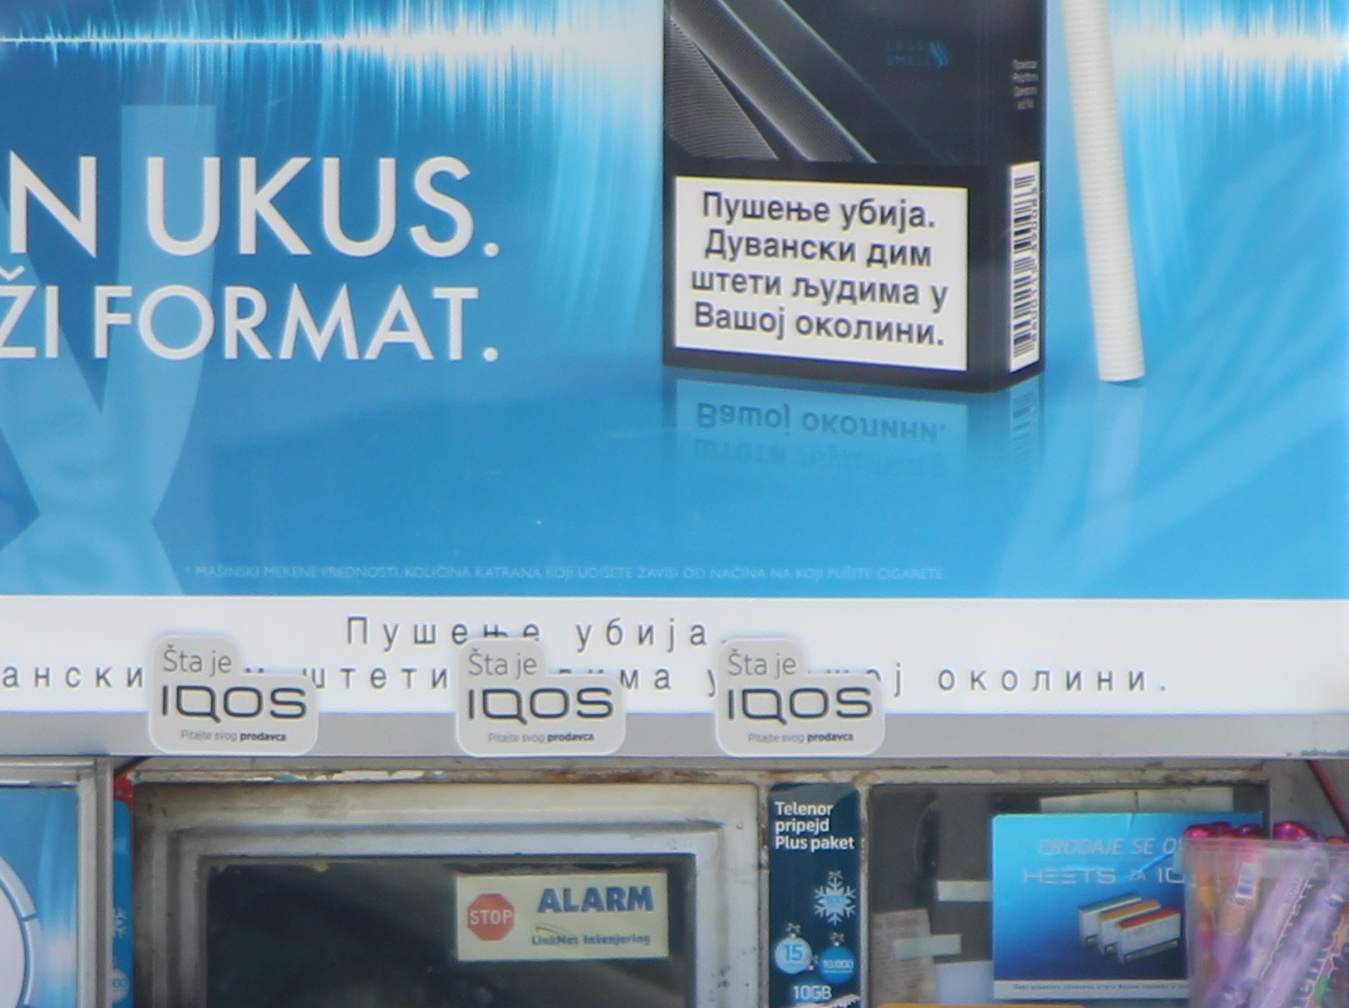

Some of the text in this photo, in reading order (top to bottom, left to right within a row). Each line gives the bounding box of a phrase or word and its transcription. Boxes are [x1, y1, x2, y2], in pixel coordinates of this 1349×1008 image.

[146, 155, 500, 258] UKUS.
[702, 191, 937, 240] Пушење убија.
[705, 229, 932, 270] Дувански дим
[691, 270, 948, 314] штети људима у
[94, 283, 499, 363] FORMAT.
[694, 301, 946, 348] Вашој околини.
[162, 644, 232, 678] Šta je
[468, 649, 537, 680] Šta je
[937, 663, 1169, 695] околини.
[162, 685, 307, 724] IQOS
[468, 688, 614, 726] IQOS
[240, 731, 287, 742] prodavca
[775, 801, 834, 817] Telenor
[774, 817, 831, 835] pripejd
[774, 834, 855, 853] Plus paket
[1038, 838, 1156, 855] PRODAJE SE
[537, 886, 655, 914] ALARM
[470, 909, 513, 926] STOP
[784, 943, 803, 963] 15
[792, 985, 832, 1001] 10GB
